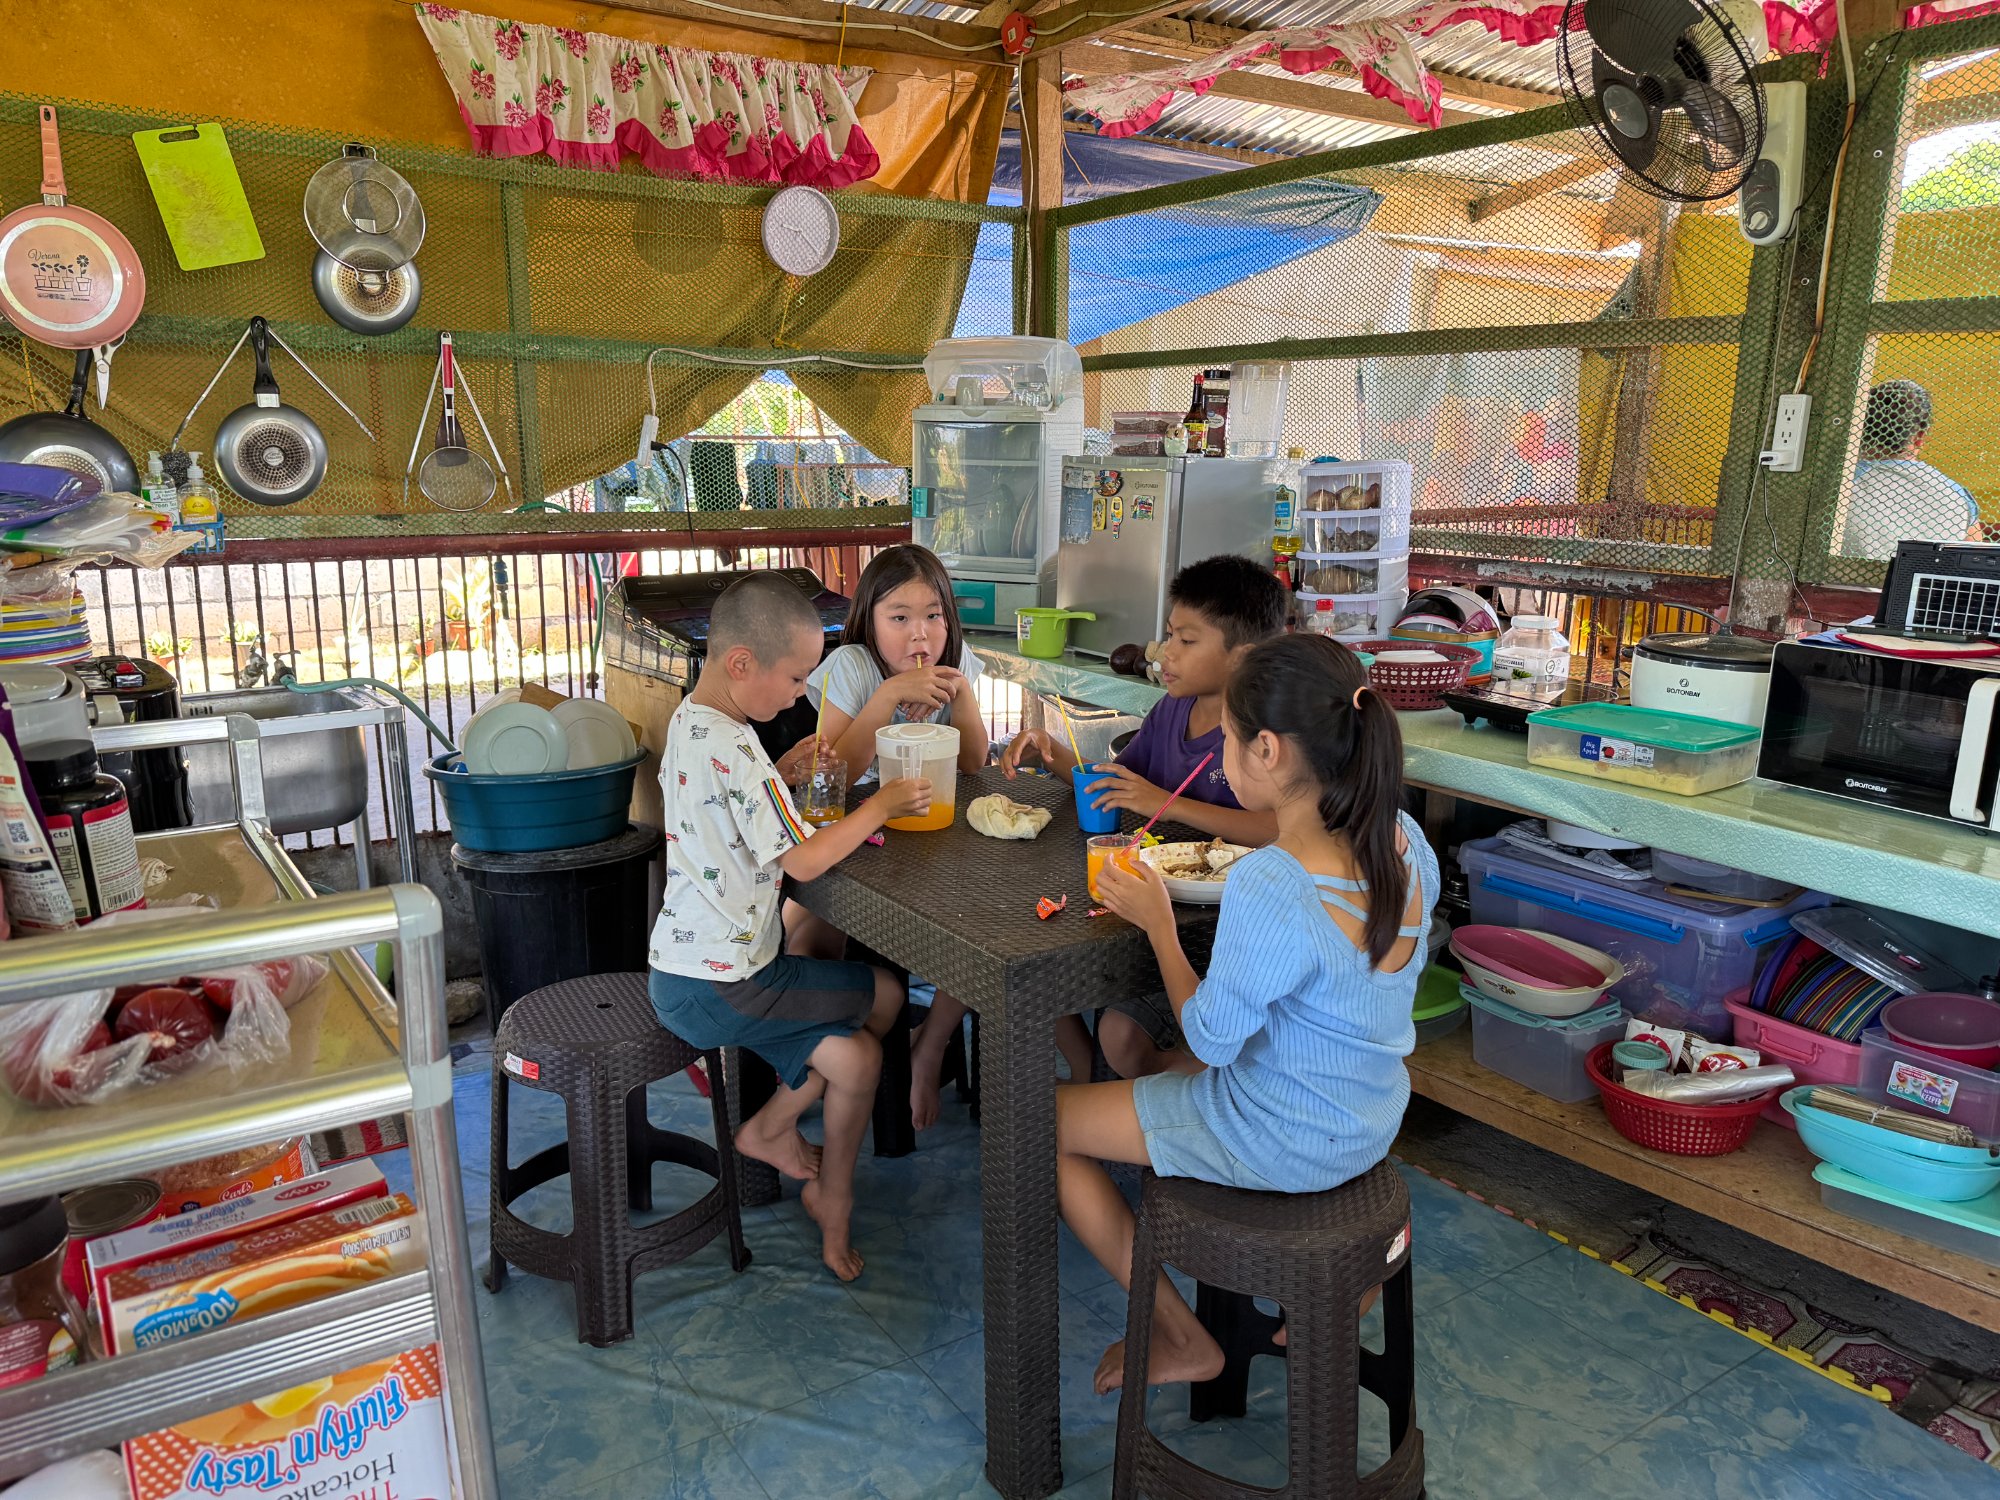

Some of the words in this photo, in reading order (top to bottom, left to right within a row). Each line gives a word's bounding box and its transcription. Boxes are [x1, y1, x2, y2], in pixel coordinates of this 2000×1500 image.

[28, 249, 60, 261] Verona
[222, 1181, 251, 1200] Carl's
[278, 1181, 328, 1199] MAYA
[319, 1376, 407, 1458] Fluffy
[187, 1448, 285, 1494] Tasty
